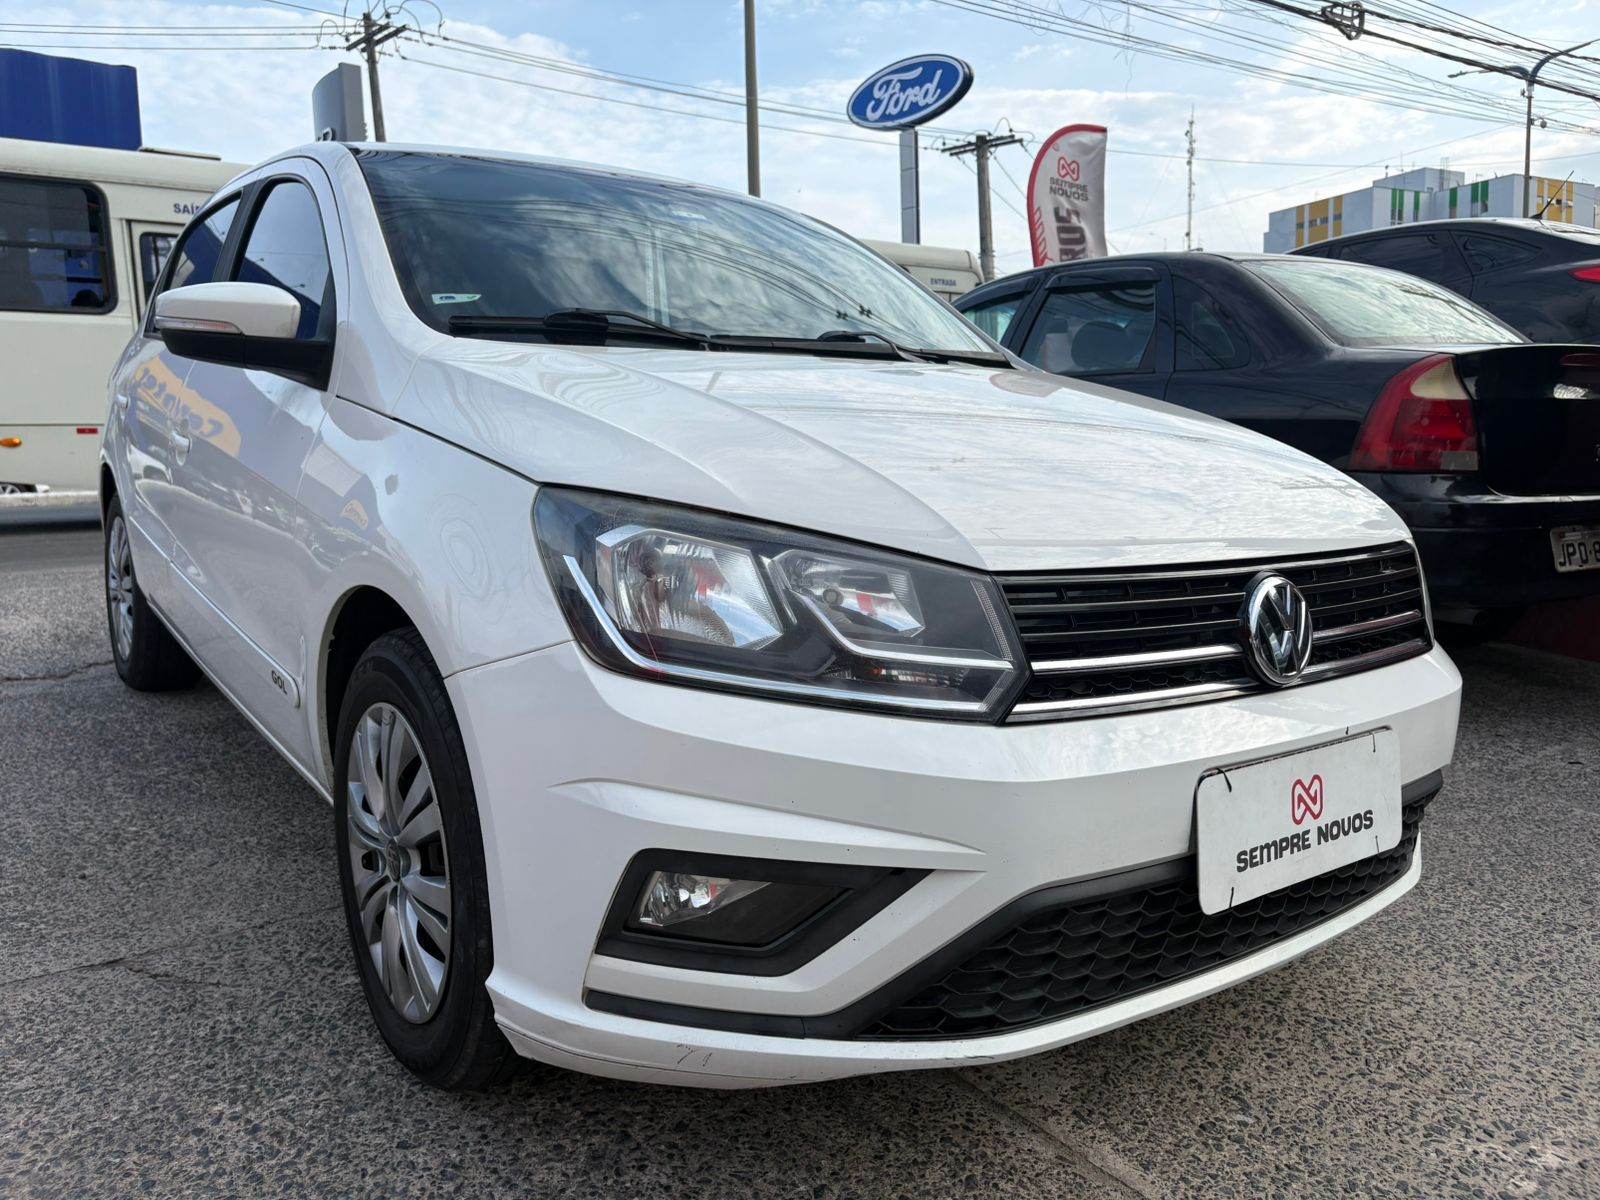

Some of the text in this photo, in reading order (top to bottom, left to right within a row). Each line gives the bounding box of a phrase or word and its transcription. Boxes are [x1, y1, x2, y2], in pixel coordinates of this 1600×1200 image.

[866, 66, 942, 121] Ford
[1050, 177, 1088, 192] SEMPRE
[174, 203, 201, 215] SAÍ
[930, 278, 957, 287] ENTRADA
[272, 670, 288, 695] GOL
[1236, 829, 1311, 873] SEMPRE
